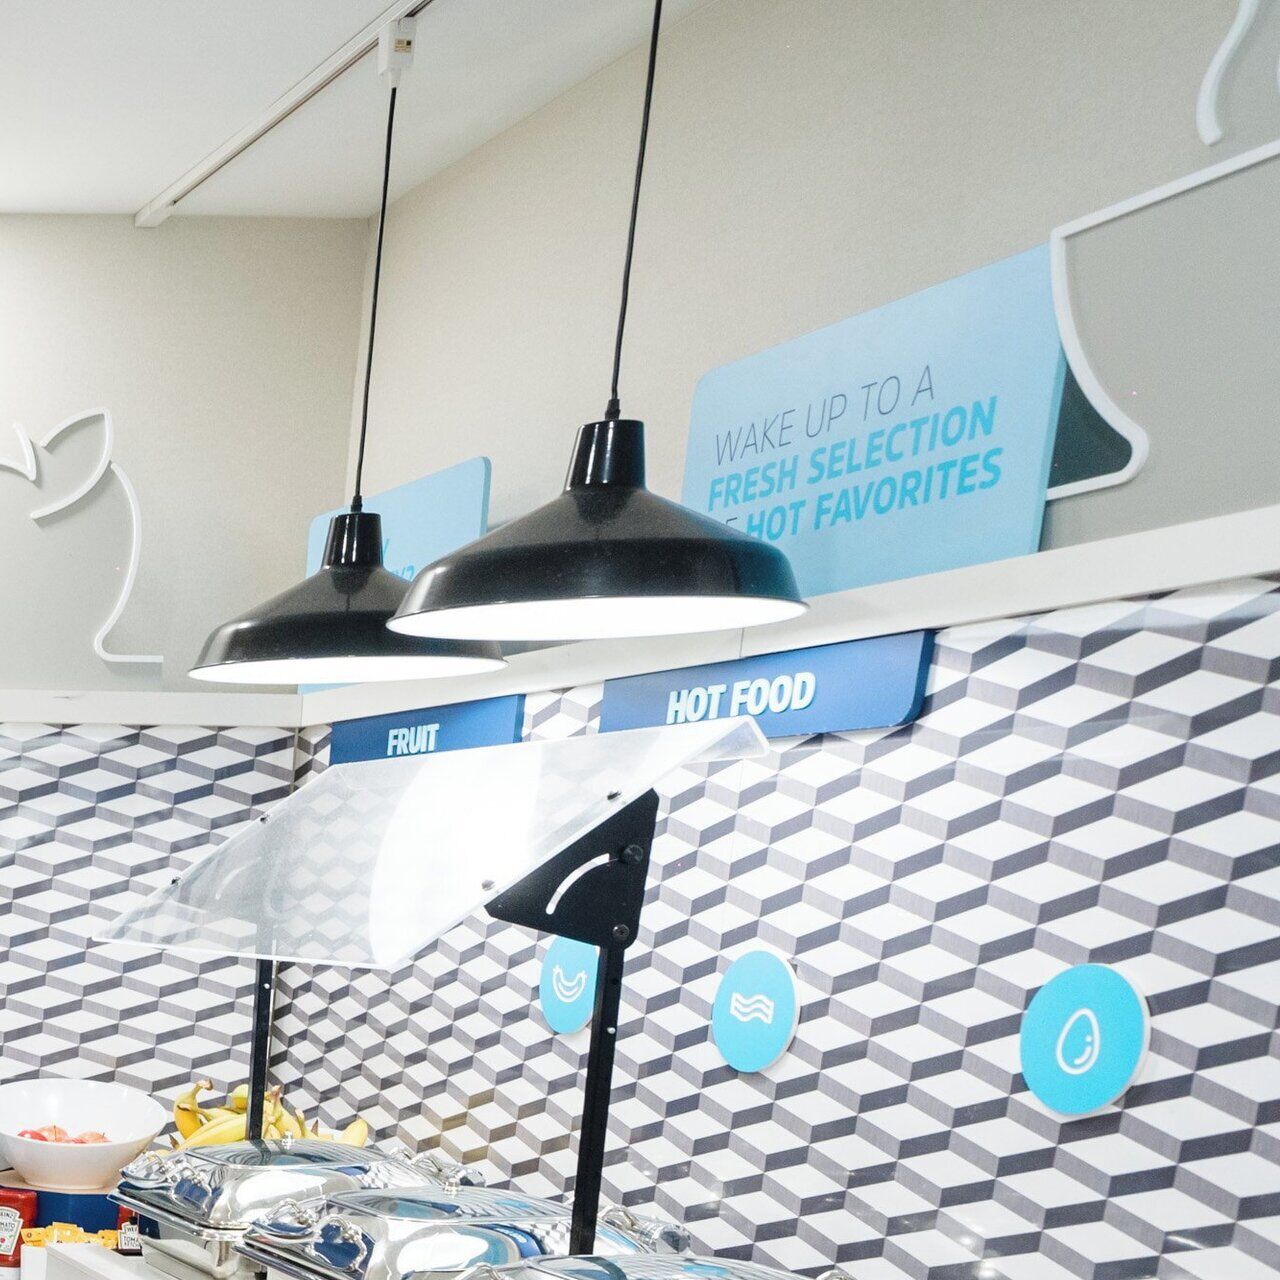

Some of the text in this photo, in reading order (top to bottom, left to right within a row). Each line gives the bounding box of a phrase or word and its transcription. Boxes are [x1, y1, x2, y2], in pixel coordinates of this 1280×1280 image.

[707, 395, 998, 513] FRESH SELECTION
[714, 364, 935, 466] WAKE UP TO A
[744, 446, 1004, 542] HOT FAVORITES
[386, 723, 440, 756] FRUIT
[666, 671, 816, 725] HOT FOOD
